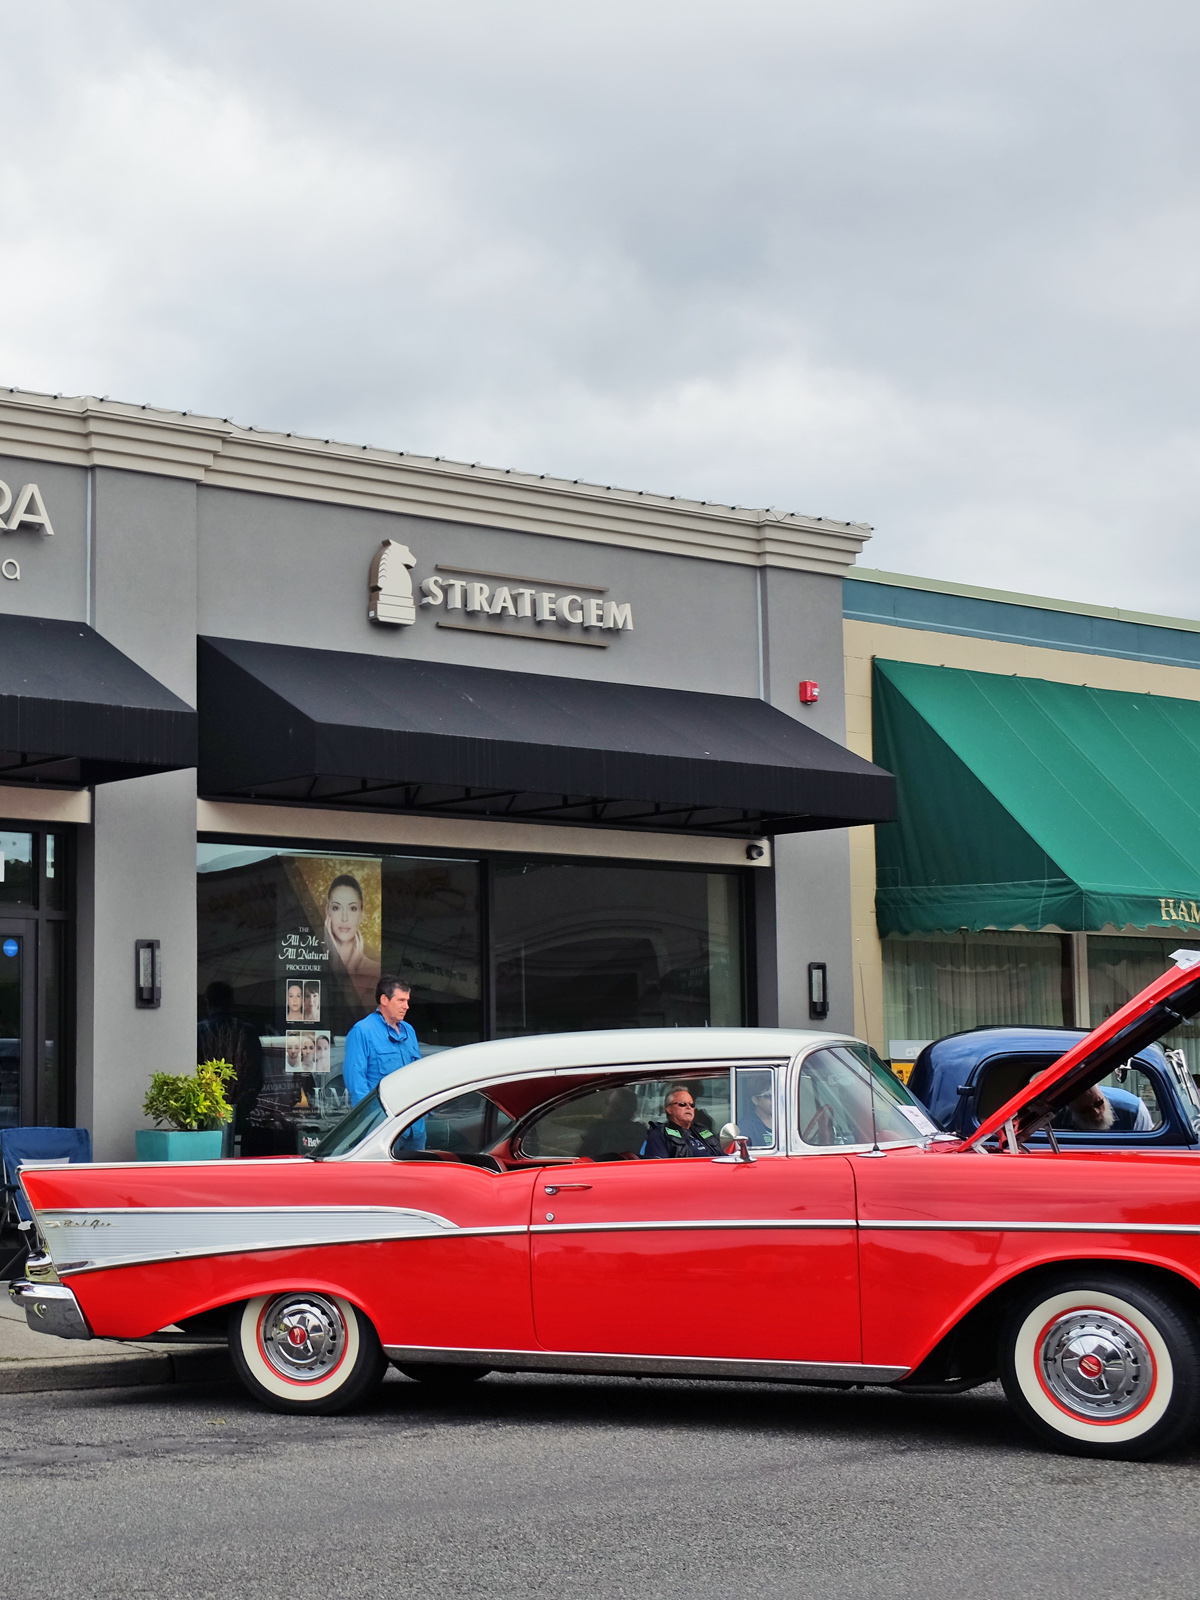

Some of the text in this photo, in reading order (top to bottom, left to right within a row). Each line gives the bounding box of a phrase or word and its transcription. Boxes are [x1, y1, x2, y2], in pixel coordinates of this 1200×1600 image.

[419, 575, 634, 631] STRATEGEM
[281, 934, 299, 946] All
[300, 935, 319, 947] Me
[278, 947, 329, 960] All Natural
